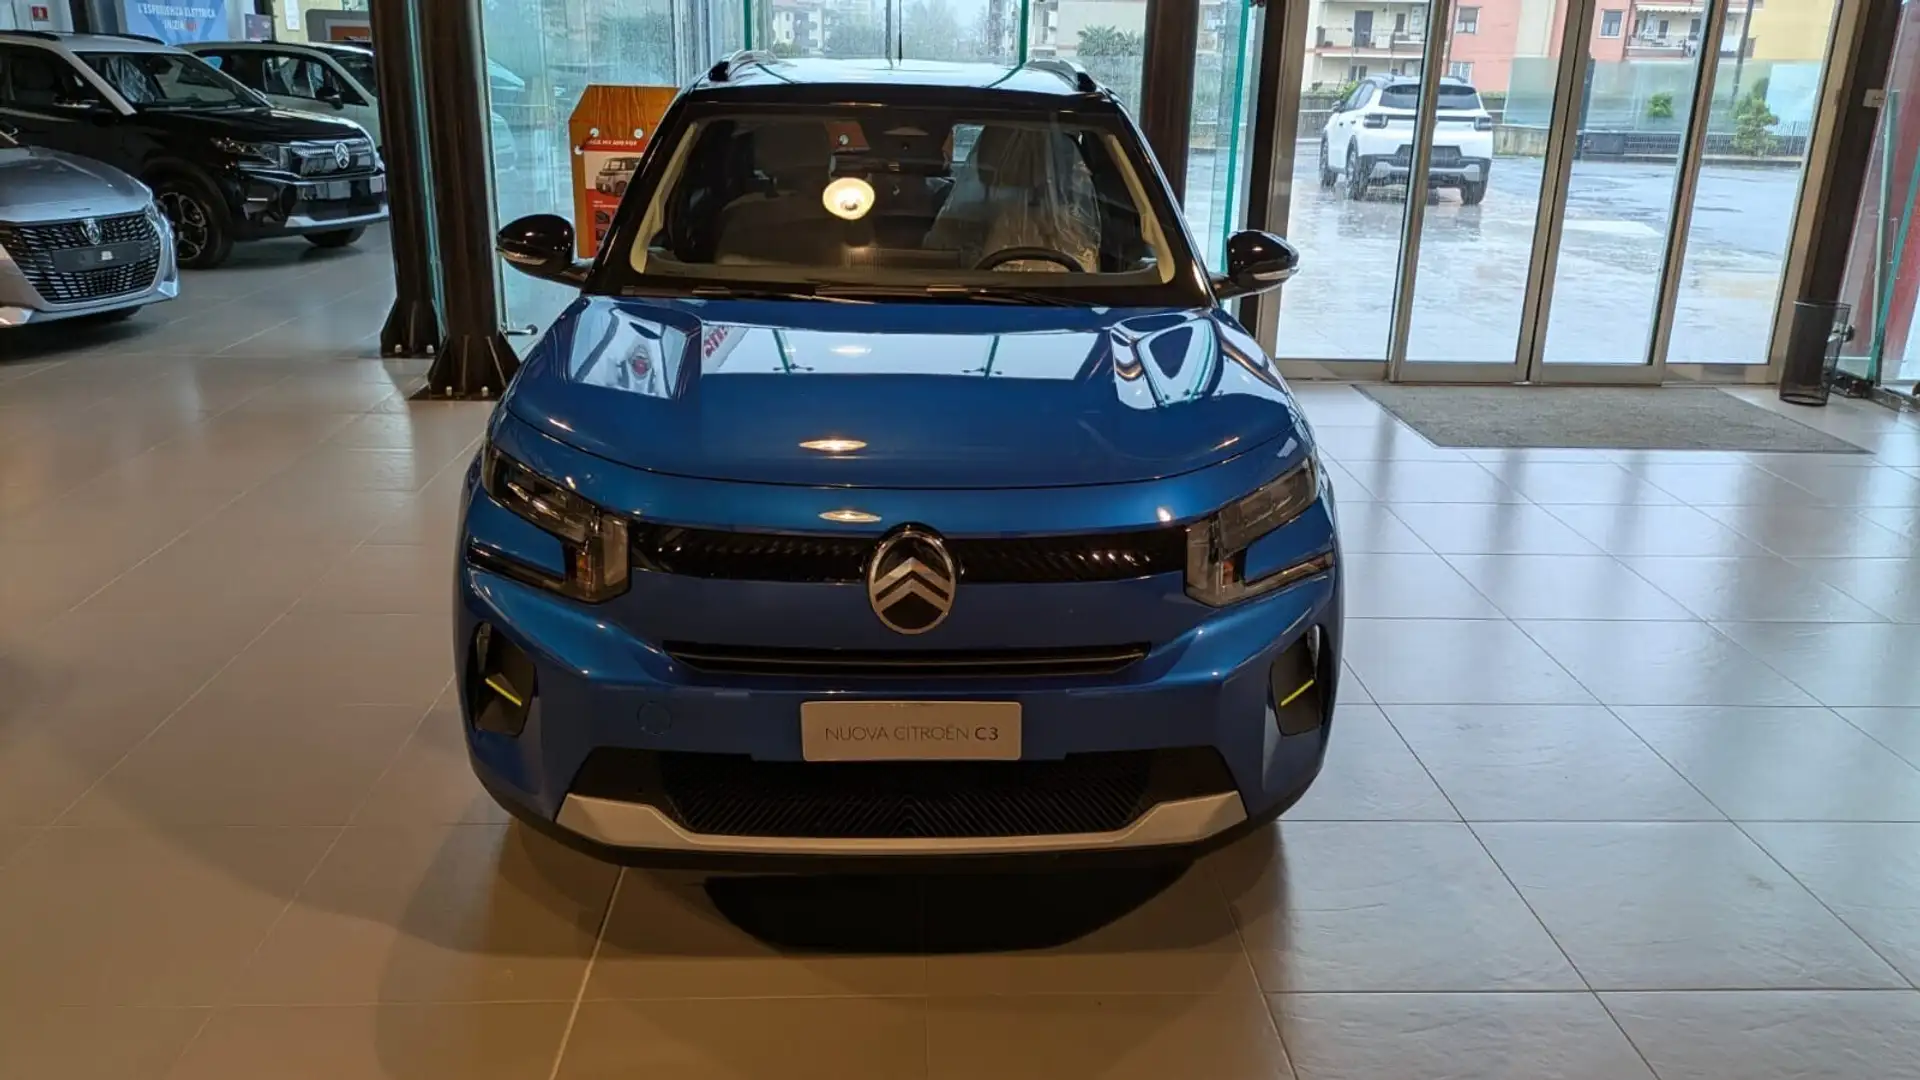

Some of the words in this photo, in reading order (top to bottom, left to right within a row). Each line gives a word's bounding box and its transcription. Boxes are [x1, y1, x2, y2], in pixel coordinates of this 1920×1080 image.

[184, 7, 216, 18] ELETTRICA
[825, 726, 888, 742] NUOVA
[893, 722, 969, 742] CITROËN
[974, 726, 999, 741] C3
